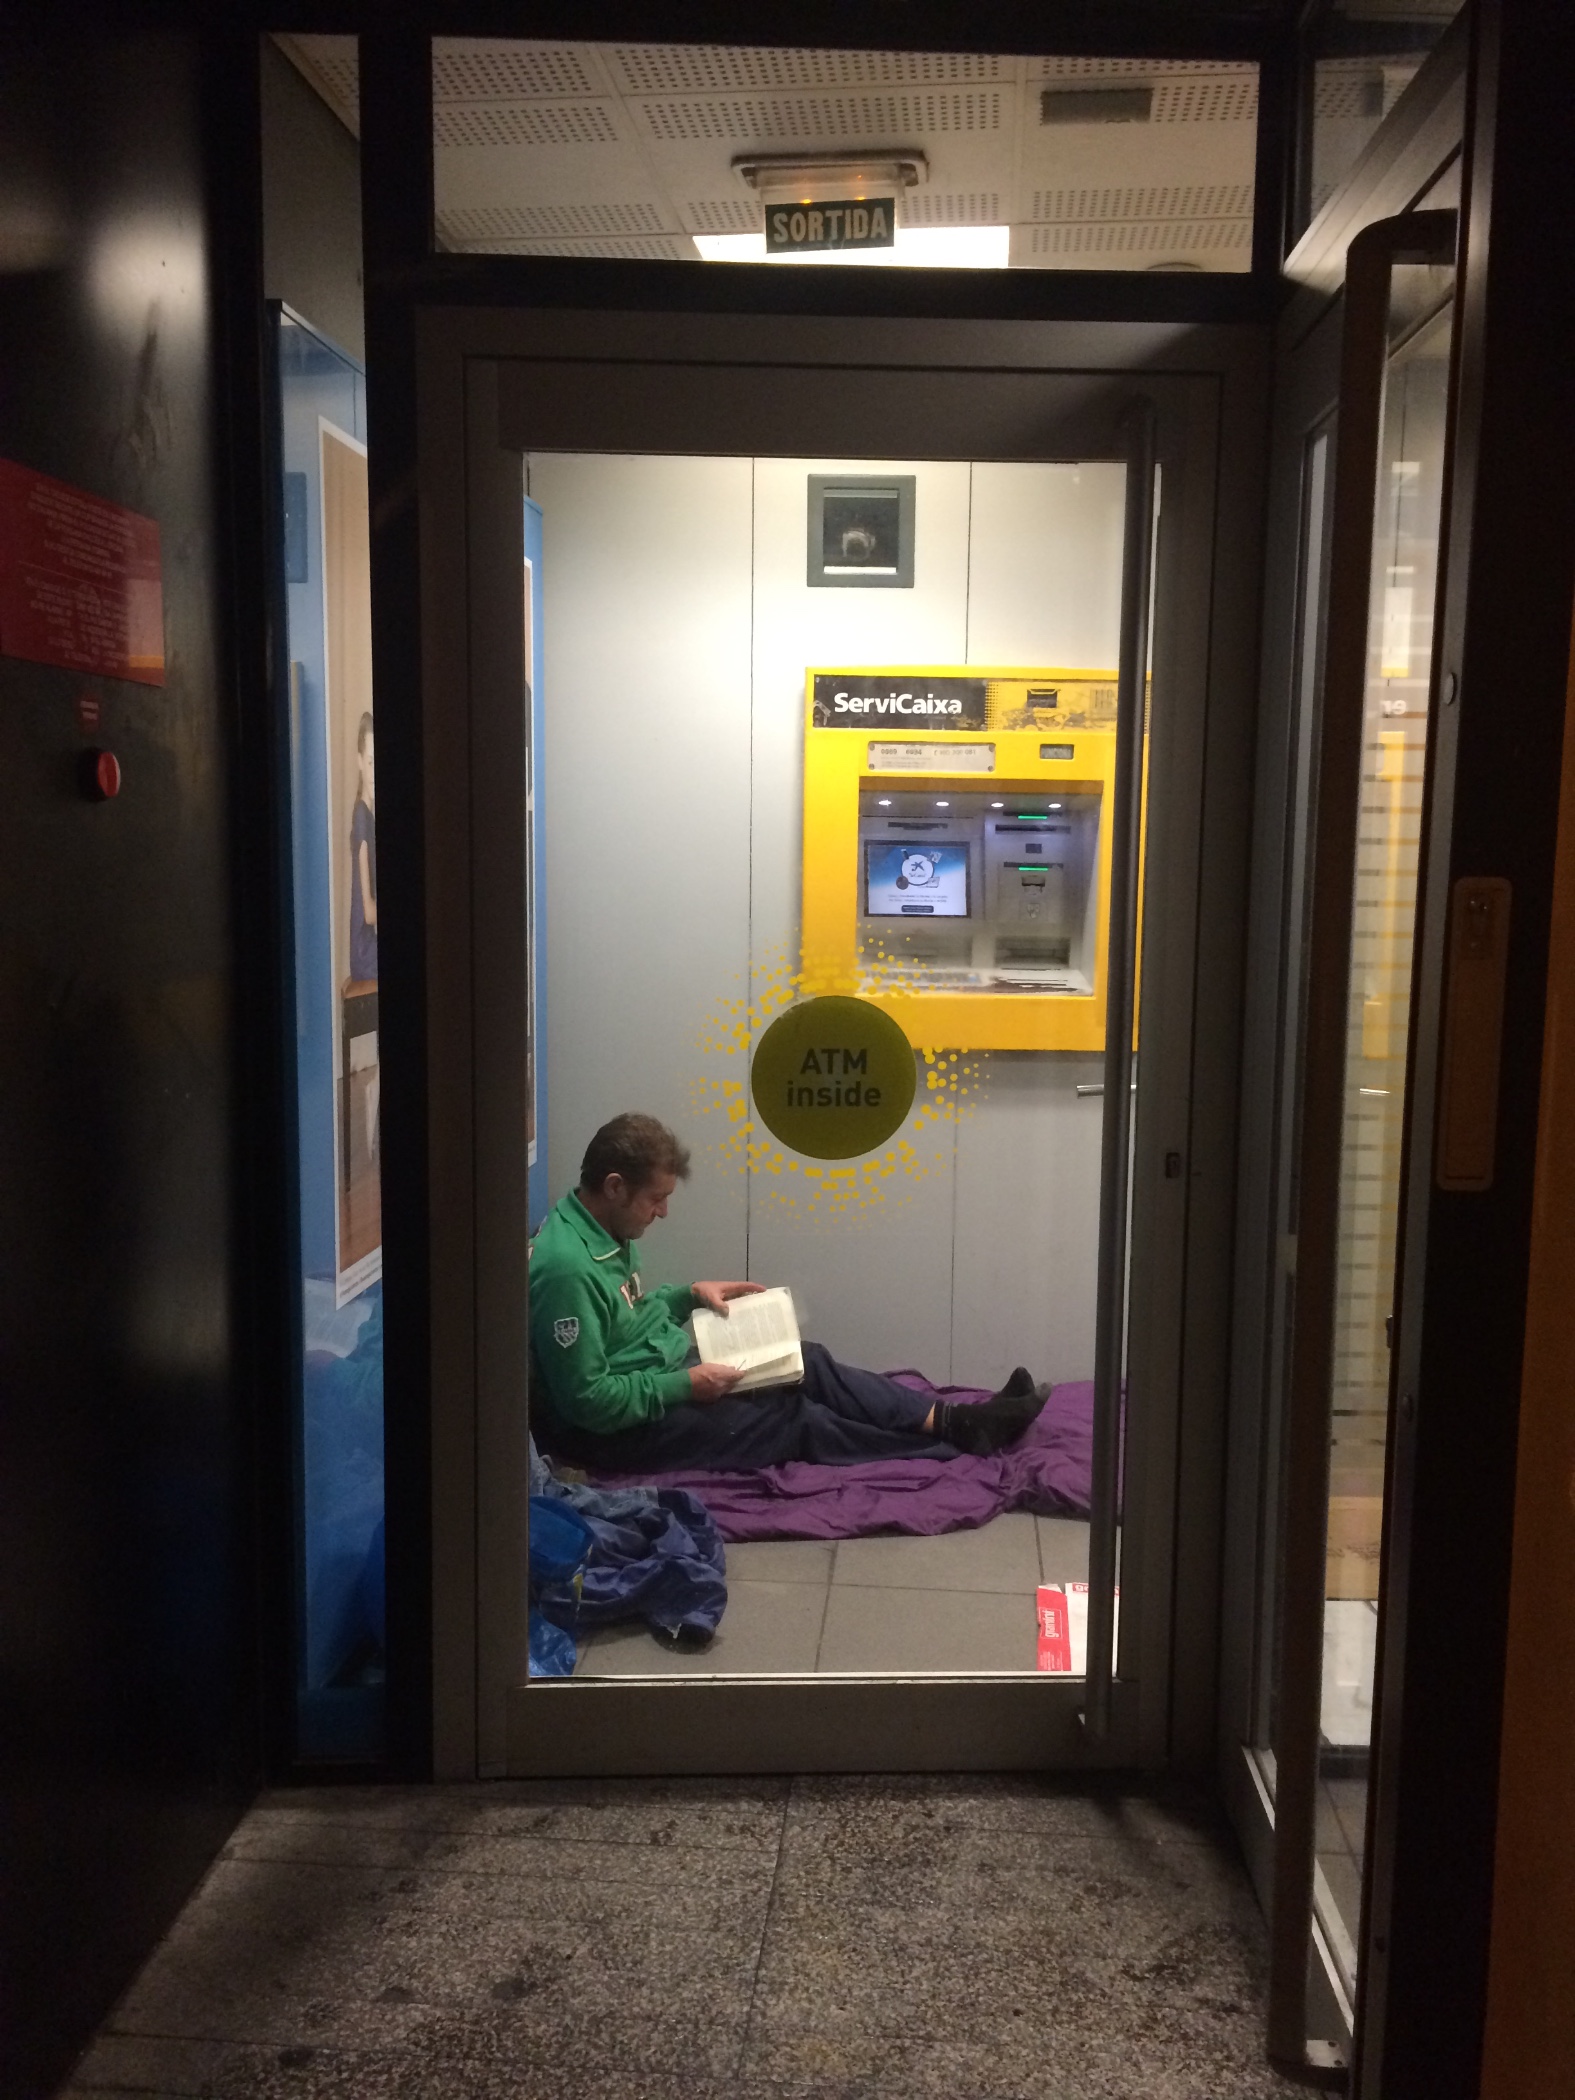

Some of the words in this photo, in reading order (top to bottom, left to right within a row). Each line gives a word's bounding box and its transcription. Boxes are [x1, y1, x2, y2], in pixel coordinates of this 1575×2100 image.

[774, 208, 888, 243] SORTIDA
[834, 692, 962, 714] ServiCaixa
[800, 1048, 868, 1075] ATM
[786, 1080, 882, 1107] inside
